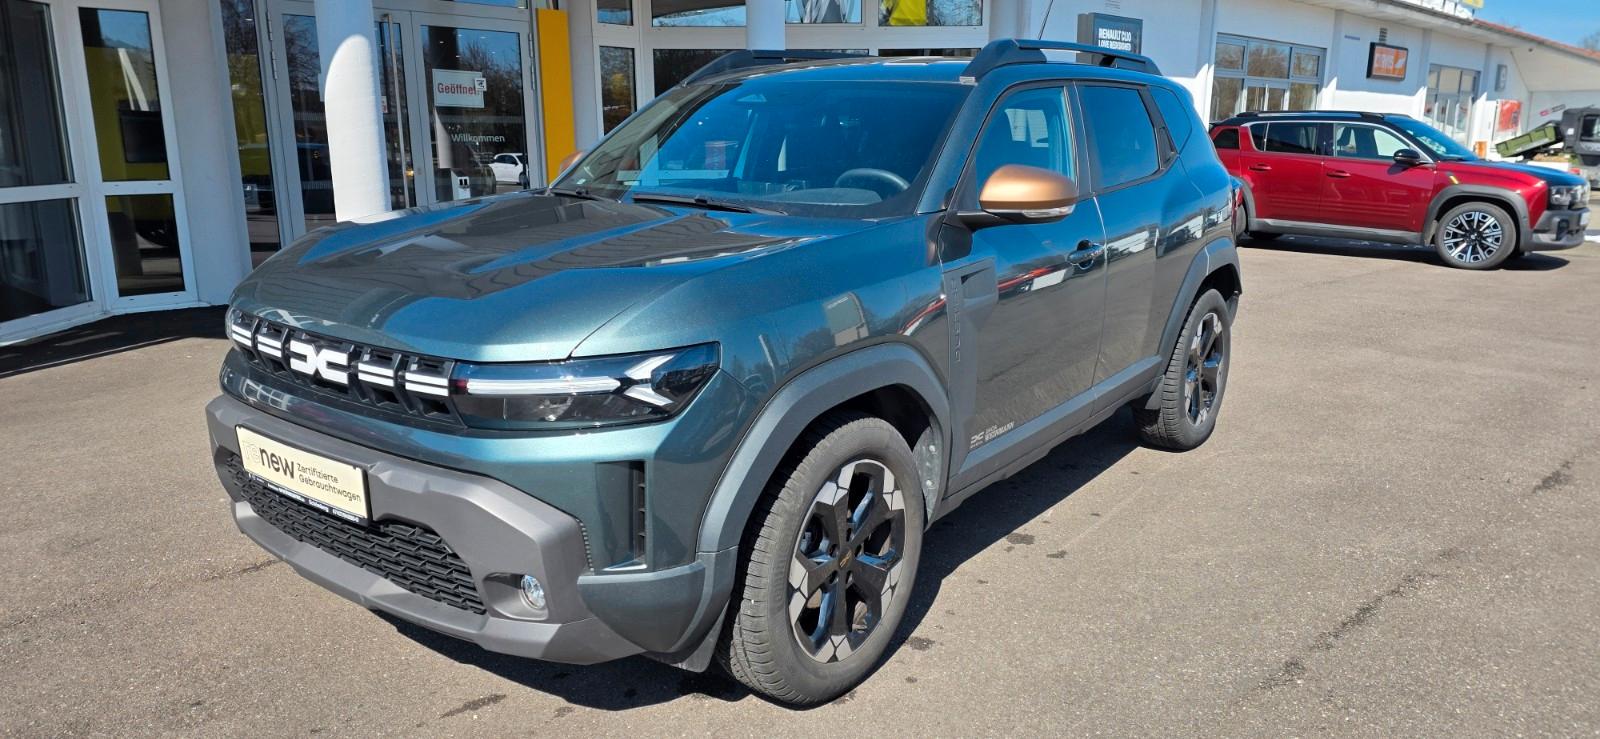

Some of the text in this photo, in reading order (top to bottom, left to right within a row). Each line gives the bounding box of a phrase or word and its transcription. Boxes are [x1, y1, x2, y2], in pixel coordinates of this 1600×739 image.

[451, 133, 505, 143] Willkommen
[297, 462, 339, 483] Zertifizierte
[299, 474, 361, 502] Gebrauchtwagen
